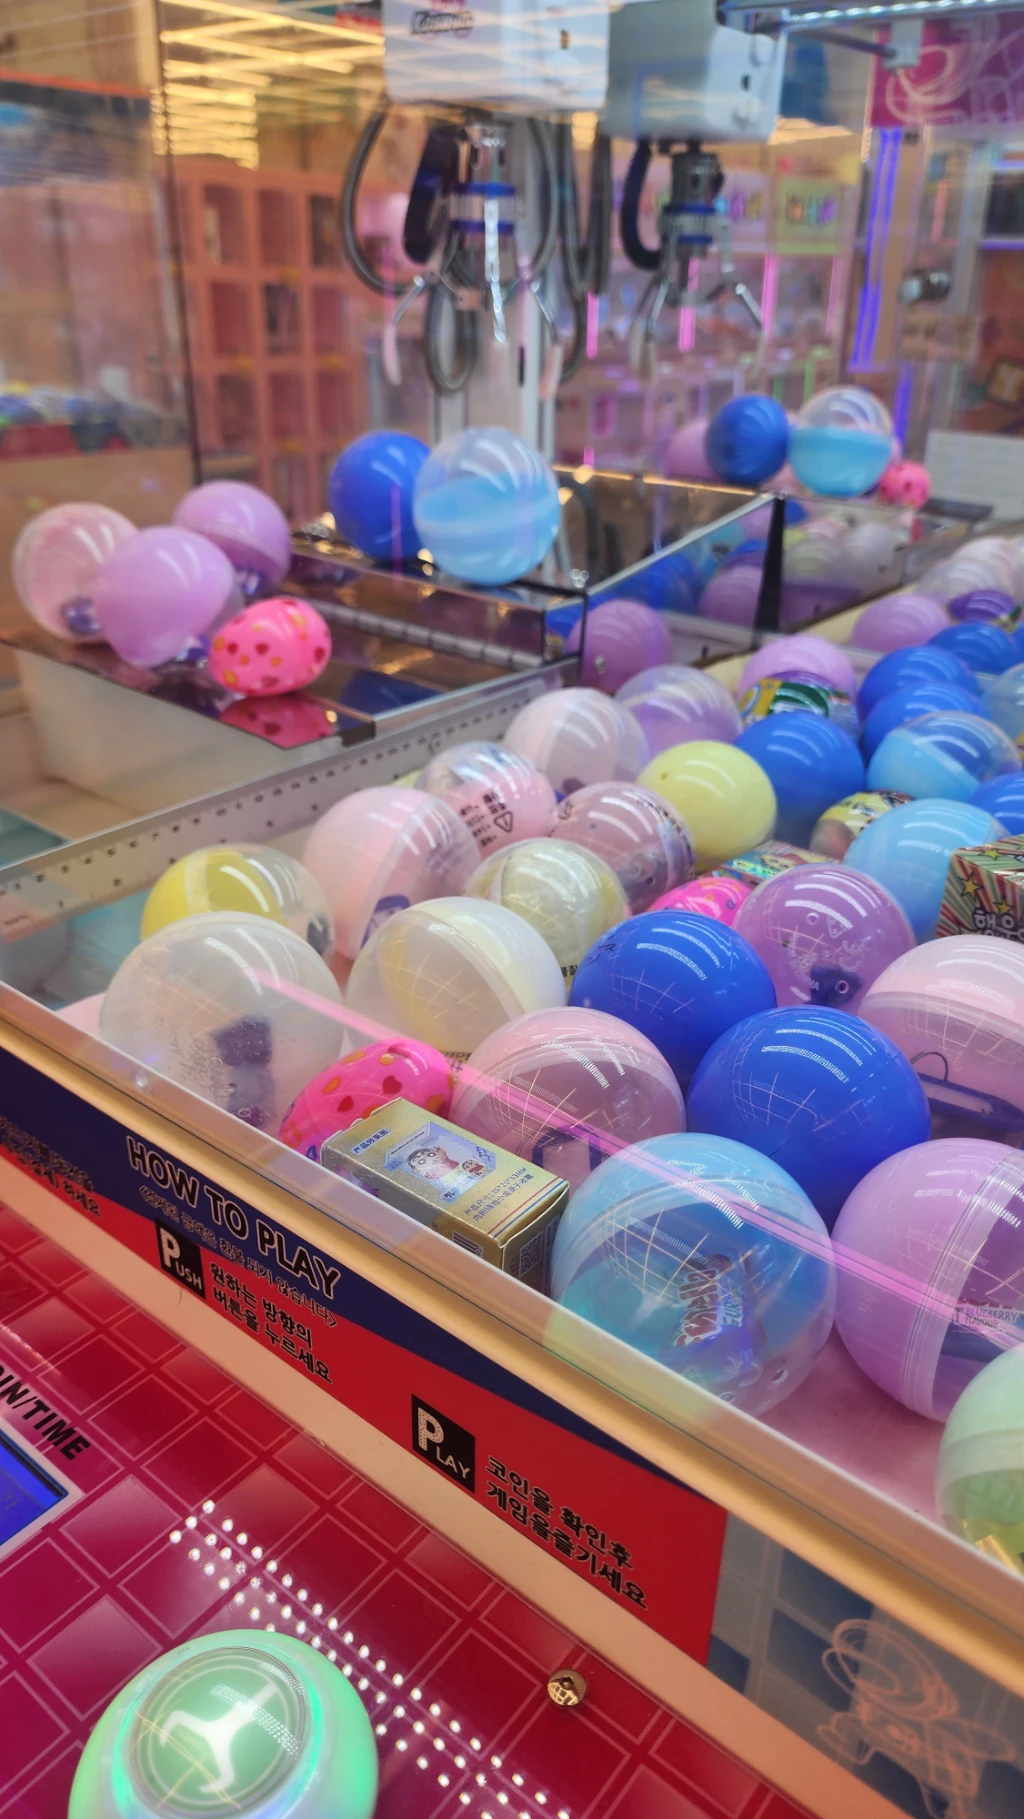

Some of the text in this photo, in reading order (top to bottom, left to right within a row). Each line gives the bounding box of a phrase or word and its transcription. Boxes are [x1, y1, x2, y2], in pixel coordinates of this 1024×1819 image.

[127, 1136, 199, 1208] HOW
[204, 1185, 248, 1240] TO
[256, 1218, 341, 1300] PLAY
[158, 1227, 202, 1290] PUSH
[210, 1262, 313, 1350] 원하는 방향의
[212, 1285, 334, 1385] 버튼을 누르세요
[965, 1307, 1018, 1323] BLUEBERRY
[0, 1365, 92, 1461] IN/TIME
[417, 1407, 471, 1480] PLAY
[485, 1455, 634, 1570] 코인을 확인후
[485, 1480, 648, 1611] 게임을즐기세요
